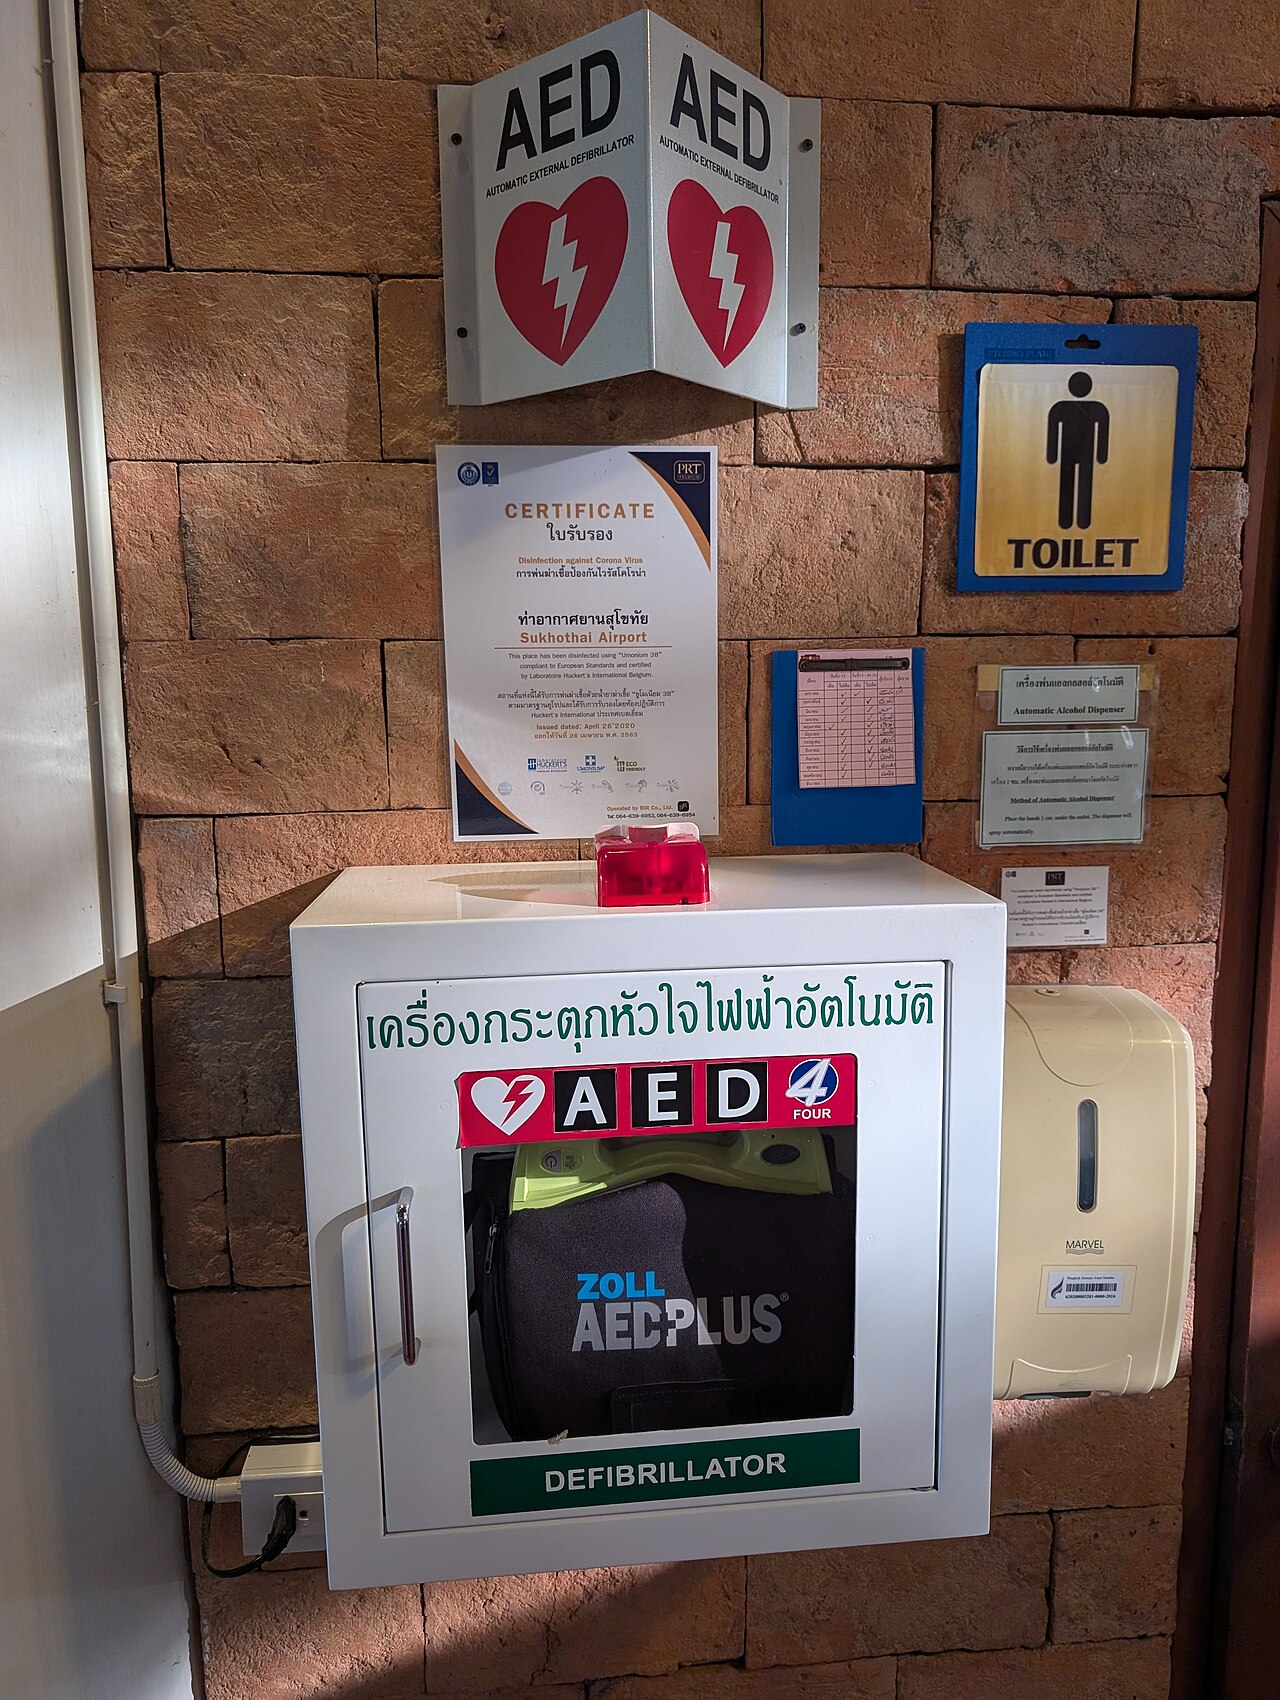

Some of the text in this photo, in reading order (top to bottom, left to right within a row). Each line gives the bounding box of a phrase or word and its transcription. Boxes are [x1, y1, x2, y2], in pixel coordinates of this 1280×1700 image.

[496, 48, 621, 172] AED
[669, 52, 771, 172] AED
[485, 134, 635, 198] AUTOMATIC EXTERNAL DEFIBRILLATOR
[659, 134, 779, 205] AUTOMATIC EXTERNAL DEFIBRILLATOR
[678, 463, 702, 474] PRT
[504, 502, 655, 519] CERTIFICATE
[546, 521, 613, 541] ใบรับรอง
[565, 557, 594, 566] against
[595, 556, 622, 564] Corona
[624, 556, 643, 564] Virus
[1007, 538, 1139, 569] TOILET
[518, 609, 648, 630] ท่าอากาศยานสุโขทัย
[520, 631, 648, 645] Sukhothai Airport
[600, 652, 617, 660] using
[557, 662, 585, 670] European
[520, 672, 528, 680] by
[1013, 706, 1125, 716] Automatic Alcohol Dispenser
[583, 723, 600, 731] April
[1101, 813, 1121, 821] dispenser
[366, 974, 935, 1053] เครื่องกระตุกหัวใจไฟฟ้าอัตโนมัติ
[792, 1107, 832, 1120] FOUR
[1065, 1239, 1104, 1249] MARVEL
[577, 1270, 666, 1301] ZOLL
[545, 1452, 787, 1493] DEFIBRILLATOR
